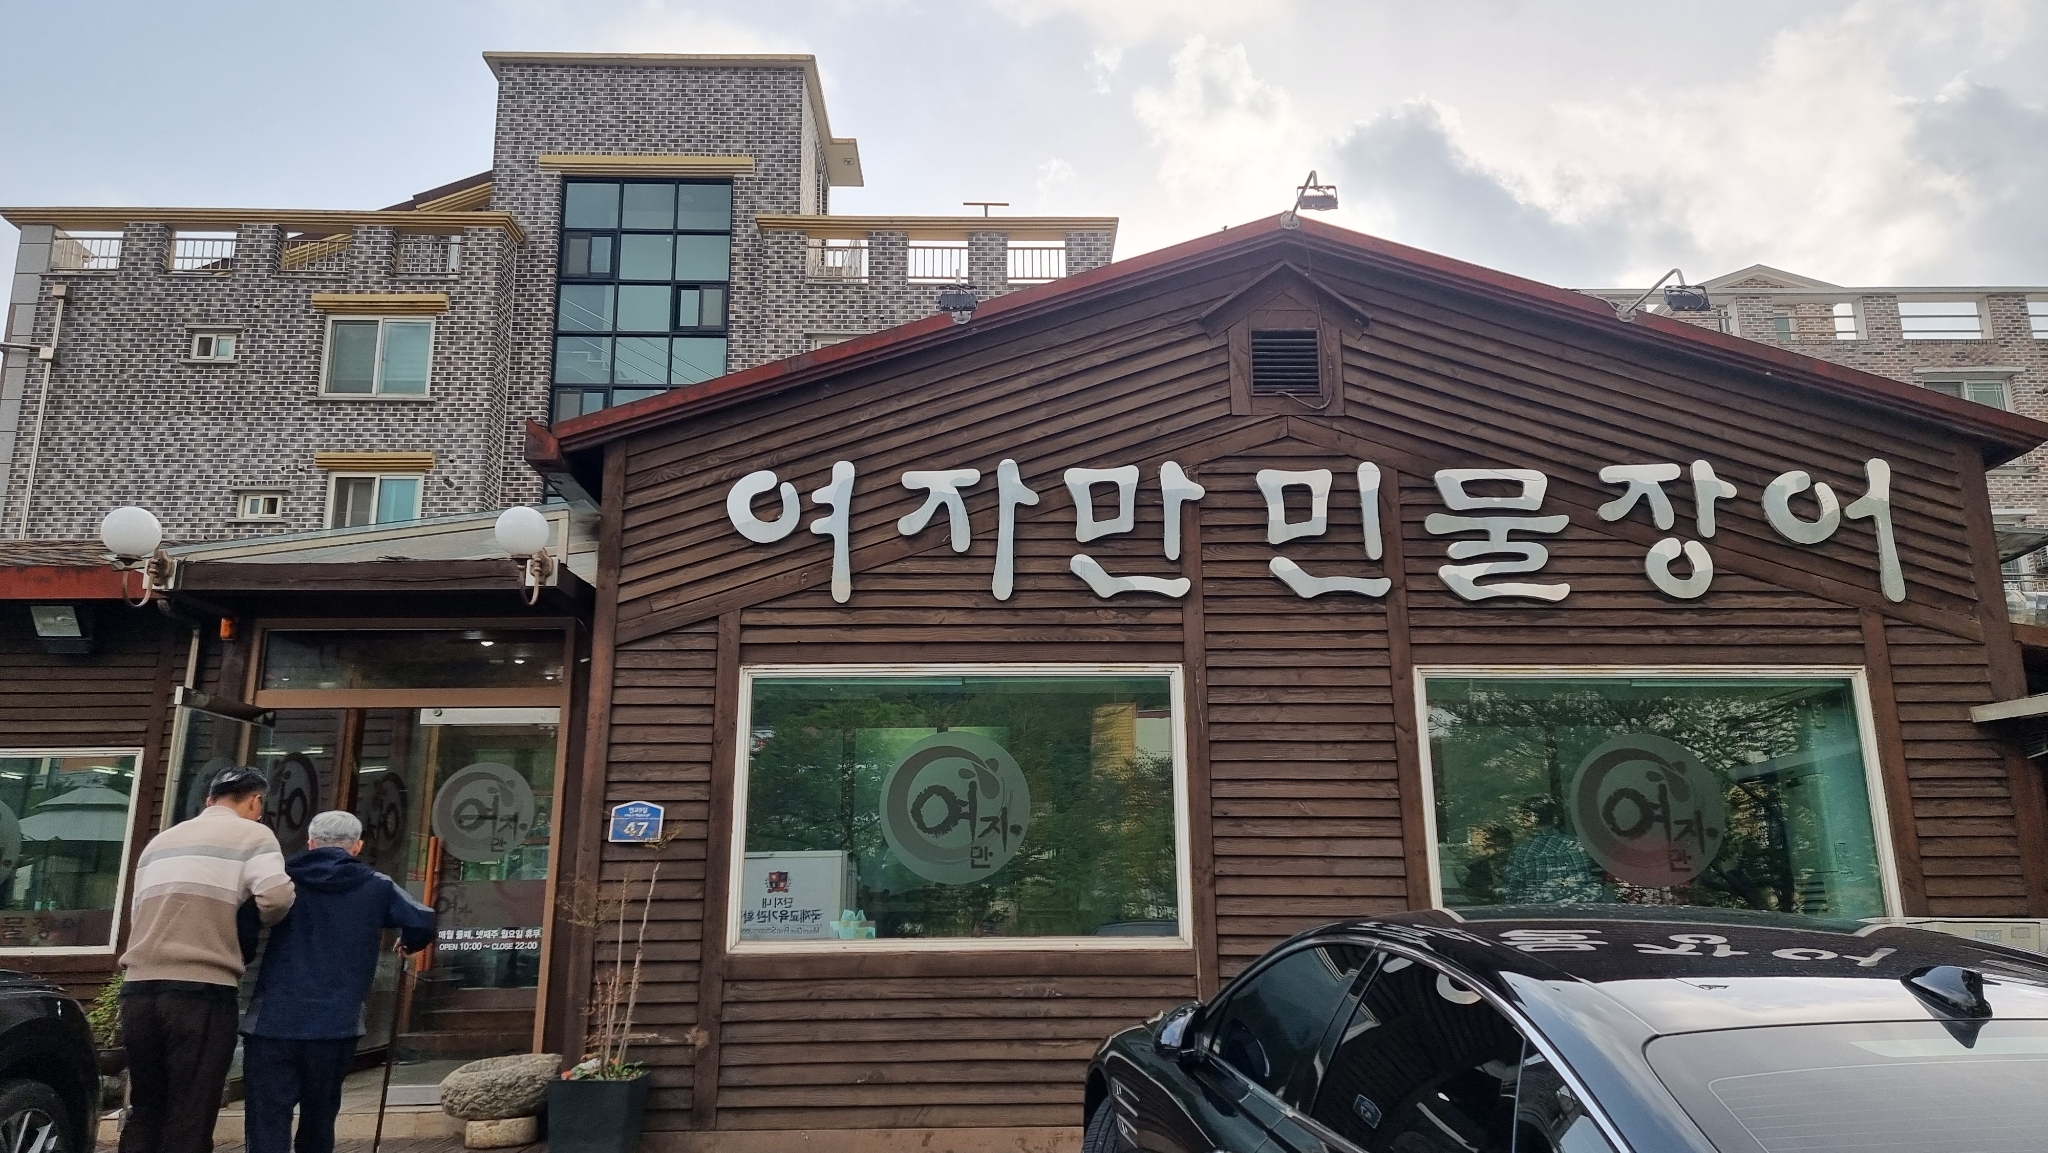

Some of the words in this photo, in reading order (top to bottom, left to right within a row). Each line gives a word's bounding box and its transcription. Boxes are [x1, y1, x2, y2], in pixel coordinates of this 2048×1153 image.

[624, 822, 650, 837] 47
[500, 929, 523, 939] 월요일
[525, 929, 541, 939] 휴무
[439, 943, 458, 951] OPEN
[460, 942, 482, 951] 10:00
[514, 941, 538, 950] 22:00
